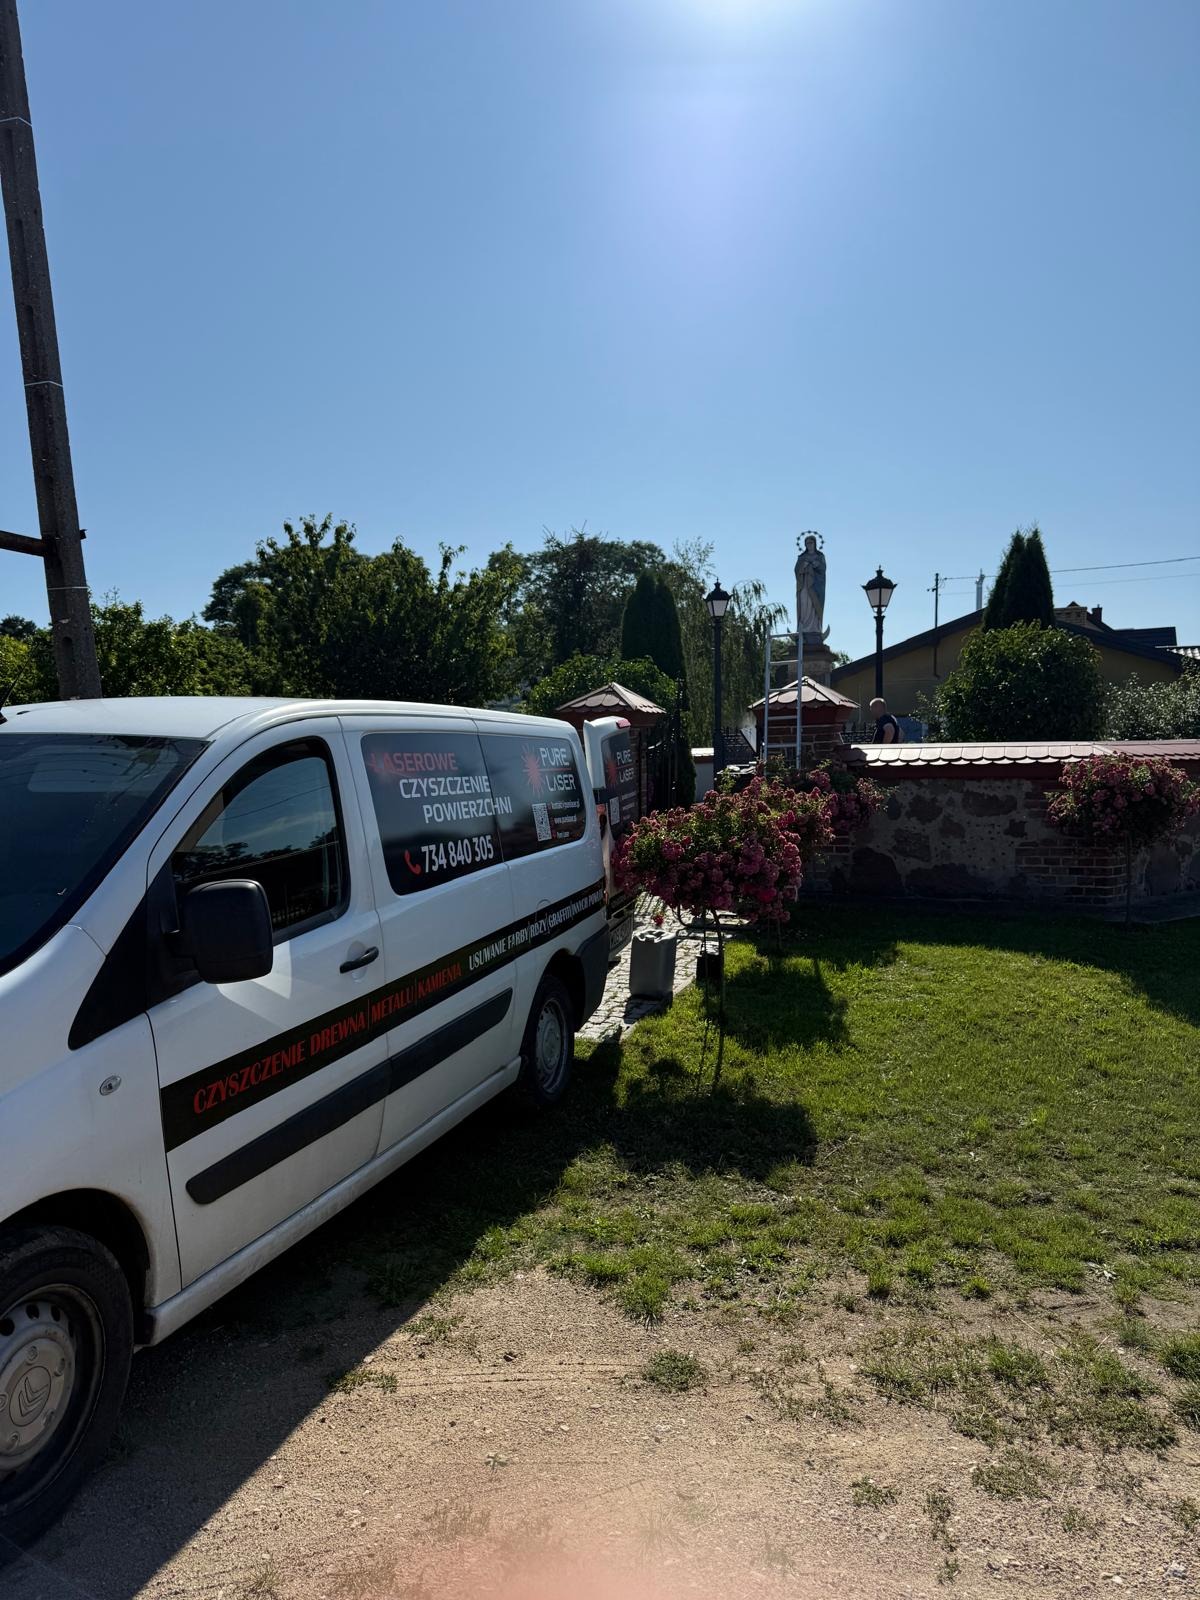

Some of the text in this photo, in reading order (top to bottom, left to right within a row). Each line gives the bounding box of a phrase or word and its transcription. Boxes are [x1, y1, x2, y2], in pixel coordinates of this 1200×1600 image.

[540, 747, 570, 767] PURE
[616, 749, 632, 765] PURE
[400, 775, 491, 799] CZYSZCZENIE
[546, 774, 576, 791] LASER
[423, 797, 512, 823] POWIERZCHNI
[421, 834, 494, 873] 734 840 305
[193, 1040, 306, 1114] CZYSZCZENIE
[310, 1011, 366, 1057] DREWNA
[372, 985, 414, 1024] METALU
[469, 937, 507, 970] USUWANIE
[507, 926, 530, 950] FARBY
[530, 920, 547, 938] RDZY
